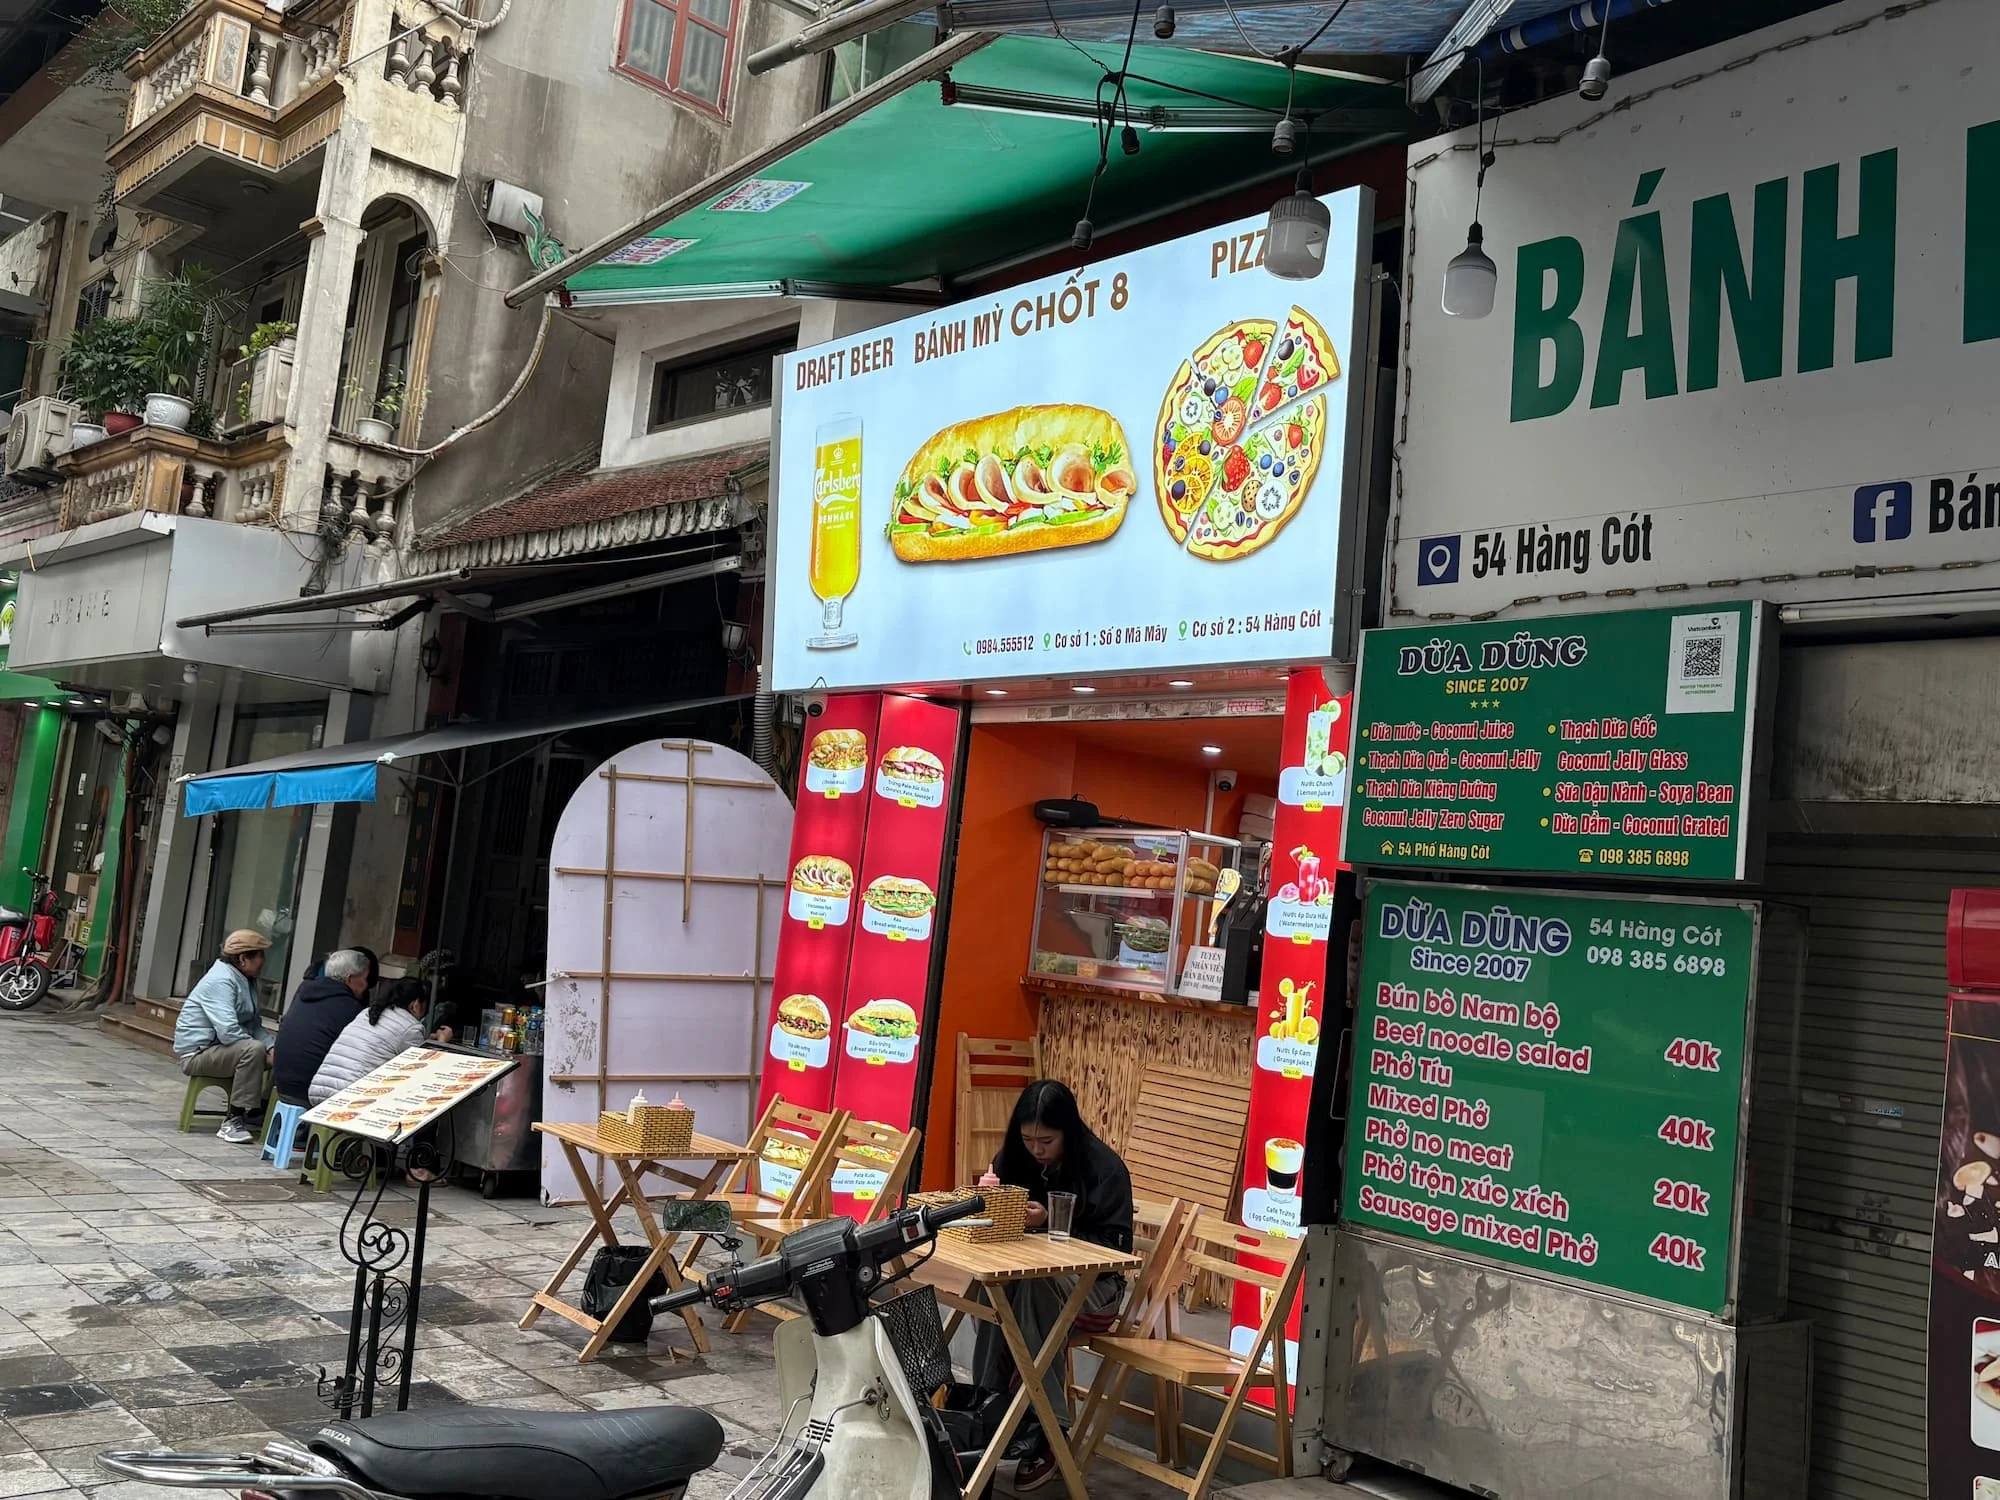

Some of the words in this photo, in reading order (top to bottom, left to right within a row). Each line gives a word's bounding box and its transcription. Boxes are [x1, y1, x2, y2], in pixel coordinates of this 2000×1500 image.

[1211, 229, 1268, 278] PIZZ
[1510, 147, 1898, 422] BÁNH
[914, 320, 966, 364] BÁNH
[972, 304, 1004, 348] MỲ
[1010, 266, 1101, 336] CHỐT
[1111, 272, 1129, 311] 8
[796, 351, 846, 390] DRAFT
[850, 337, 894, 376] BEER
[815, 464, 861, 501] Carlsberg
[1472, 532, 1507, 578] 54
[1516, 522, 1590, 575] Hàng
[1601, 513, 1653, 564] Cót
[976, 636, 1034, 654] 0984.555512
[1055, 633, 1069, 648] Cơ
[1070, 629, 1081, 648] sở
[1085, 631, 1090, 647] 1
[1100, 628, 1113, 645] Số
[1115, 629, 1122, 645] 8
[1125, 627, 1141, 643] Mã
[1193, 621, 1207, 637] Cơ
[1211, 616, 1223, 635] sở
[1228, 618, 1235, 634] 2
[1246, 616, 1260, 633] 54
[1265, 612, 1295, 632] Hàng
[1300, 610, 1321, 628] Cót
[1397, 638, 1470, 675] DỪA
[1480, 633, 1588, 671] DŨNG
[1446, 680, 1485, 694] SINCE
[1491, 677, 1529, 692] 2007
[1370, 723, 1391, 741] Dừa
[1393, 721, 1421, 741] nước
[1431, 722, 1478, 740] Coconut
[1480, 722, 1514, 739] Juice
[1560, 718, 1598, 745] Thạch
[1602, 718, 1628, 738] Dừa
[1630, 714, 1657, 738] Cốc
[1369, 751, 1400, 774] Thạch
[1403, 751, 1425, 769] Dừa
[1427, 751, 1449, 772] Quả
[1459, 751, 1506, 770] Coconut
[1510, 750, 1540, 771] Jelly
[1558, 752, 1611, 772] Coconut
[1614, 751, 1647, 772] Jelly
[1650, 750, 1687, 770] Glass
[1366, 779, 1397, 803] Thạch
[1400, 779, 1422, 798] Dừa
[1425, 779, 1456, 801] Kiêng
[1458, 779, 1497, 802] Đường
[1555, 782, 1580, 803] Sữa
[1583, 783, 1609, 808] Đậu
[1612, 781, 1646, 803] Nành
[1659, 784, 1693, 806] Soya
[1696, 783, 1733, 803] Bean
[1362, 809, 1407, 828] Coconut
[1409, 809, 1436, 829] Jelly
[1440, 812, 1466, 829] Zero
[1469, 812, 1504, 832] Sugar
[1553, 814, 1577, 834] Dừa
[1623, 814, 1680, 836] Coconut
[1682, 814, 1730, 836] Grated
[1398, 843, 1412, 856] 54
[1415, 841, 1436, 857] Phố
[1439, 844, 1466, 860] Hàng
[1468, 844, 1490, 860] Cót
[1599, 850, 1622, 864] 098
[1626, 850, 1652, 865] 385
[1655, 850, 1689, 866] 6898
[1380, 895, 1451, 946] DỪA
[1460, 906, 1571, 956] DŨNG
[1589, 917, 1614, 937] 54
[1619, 919, 1676, 948] Hàng
[1682, 923, 1722, 947] Cót
[1411, 948, 1469, 974] Since
[1474, 956, 1531, 982] 2007
[1587, 947, 1622, 967] 098
[1629, 950, 1667, 971] 385
[1673, 954, 1726, 977] 6898
[1377, 982, 1418, 1012] Bún
[1424, 989, 1456, 1016] bò
[1460, 992, 1518, 1025] Nam
[1524, 998, 1560, 1037] bộ
[1373, 1017, 1425, 1045] Beef
[1428, 1026, 1511, 1060] noodle
[1518, 1041, 1591, 1073] salad
[1664, 1039, 1721, 1071] 40k
[1371, 1050, 1413, 1078] Phở
[1419, 1057, 1453, 1086] Tíu
[1368, 1086, 1438, 1117] Mixed
[1442, 1097, 1490, 1129] Phở
[1365, 1119, 1408, 1147] Phở
[1413, 1128, 1442, 1155] no
[1449, 1138, 1513, 1170] meat
[1658, 1116, 1715, 1150] 40k
[1362, 1152, 1406, 1183] Phở
[1410, 1158, 1456, 1197] trộn
[1461, 1175, 1508, 1205] xúc
[1512, 1186, 1569, 1219] xích
[1653, 1179, 1709, 1216] 20k
[1359, 1187, 1457, 1233] Sausage
[1463, 1212, 1539, 1252] mixed
[1546, 1230, 1599, 1265] Phở
[1648, 1235, 1706, 1270] 40k
